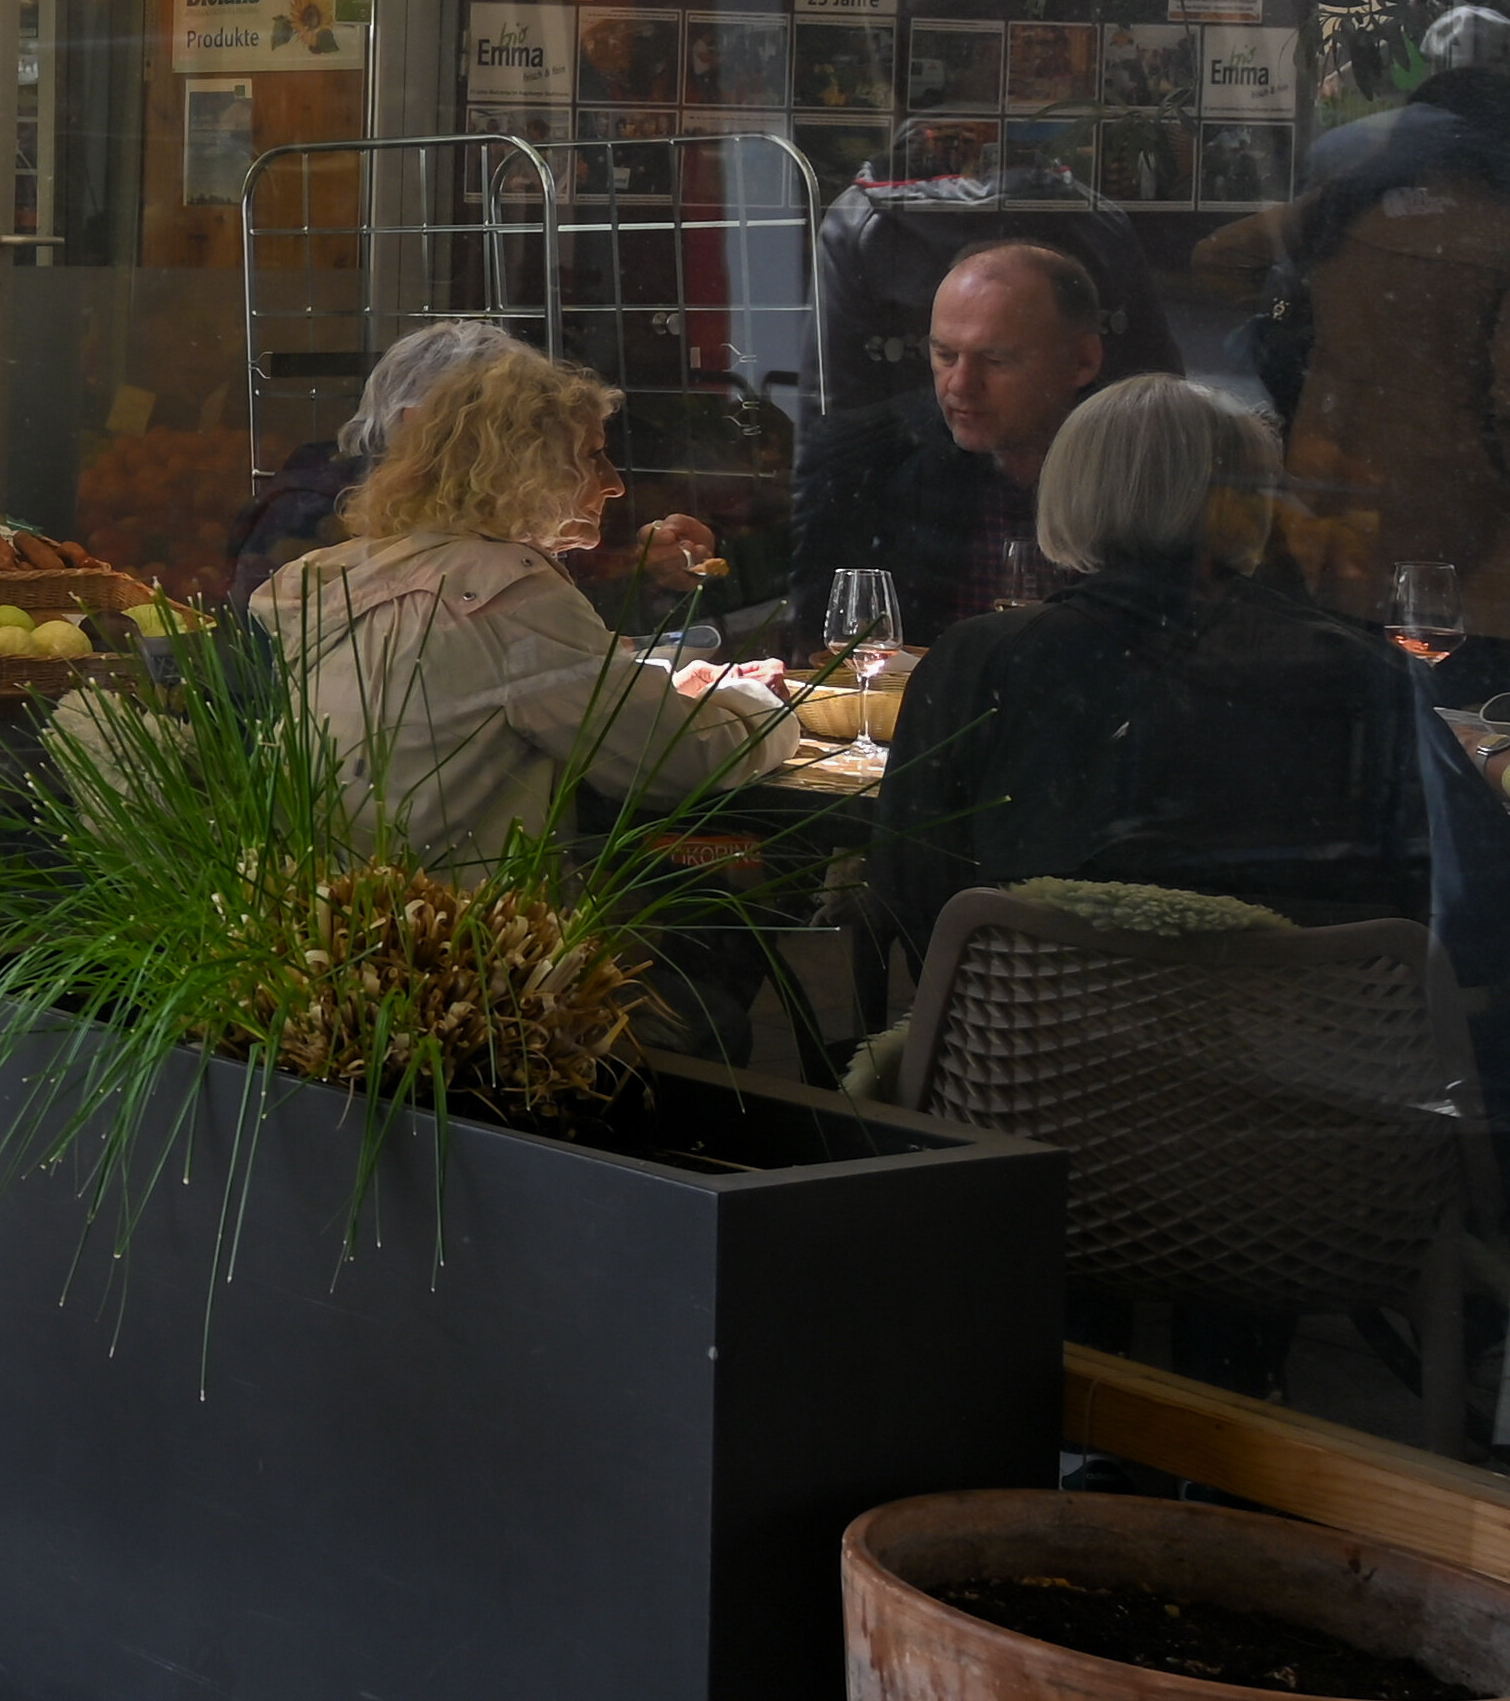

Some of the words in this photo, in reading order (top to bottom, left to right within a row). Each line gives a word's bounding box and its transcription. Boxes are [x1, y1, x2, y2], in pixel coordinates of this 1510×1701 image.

[187, 26, 260, 49] Produkte
[500, 21, 529, 47] bio
[477, 38, 544, 68] Emma
[1210, 59, 1270, 86] Emma
